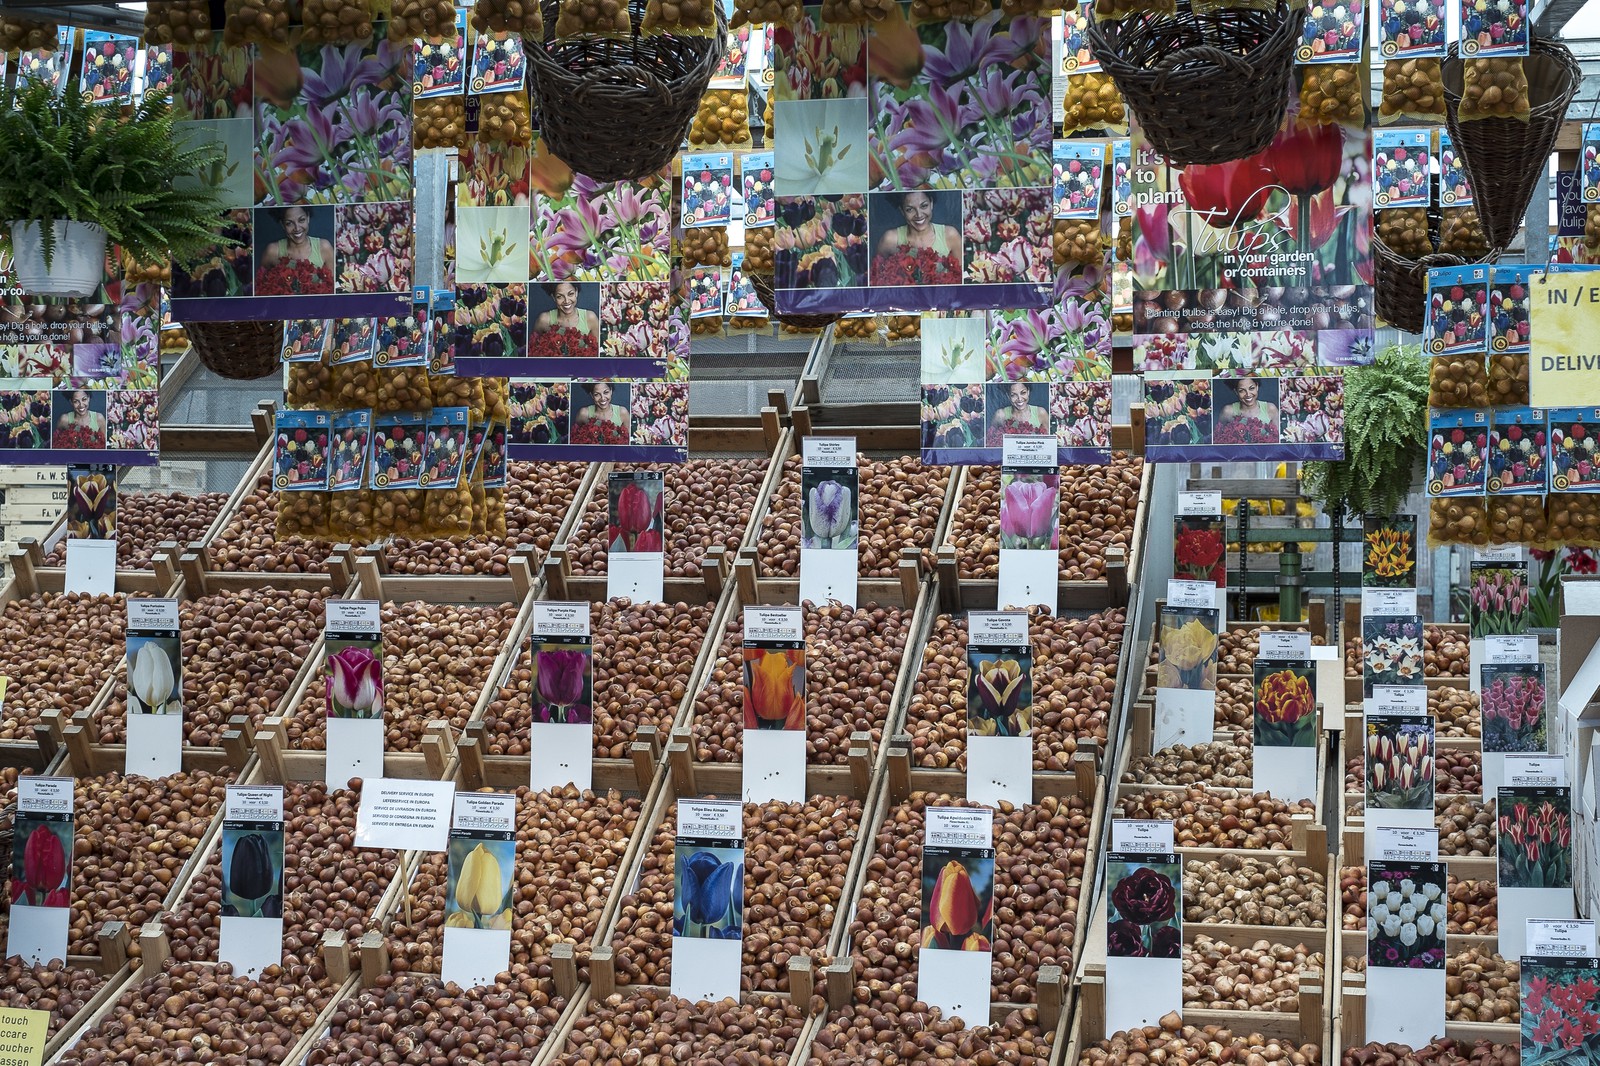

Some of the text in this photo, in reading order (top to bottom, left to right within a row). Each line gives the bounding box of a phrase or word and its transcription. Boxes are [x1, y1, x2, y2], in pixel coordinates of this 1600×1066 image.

[1136, 149, 1164, 165] It's
[1136, 169, 1156, 183] to
[1137, 188, 1184, 208] plant
[1168, 185, 1293, 270] Tulips
[1224, 250, 1315, 268] in your garden
[1224, 266, 1306, 278] or containers
[1548, 289, 1567, 304] IN
[1573, 286, 1583, 306] /
[1146, 309, 1180, 318] Planting
[1182, 308, 1206, 317] bulbs
[1208, 308, 1215, 316] is
[1217, 307, 1240, 318] easy!
[1242, 306, 1257, 316] Dig
[1266, 306, 1288, 315] hole,
[1290, 305, 1311, 316] drop
[1311, 306, 1331, 315] your
[1333, 304, 1360, 314] bulbs,
[11, 322, 24, 331] Dig
[31, 322, 49, 330] hole,
[50, 321, 68, 331] drop
[68, 322, 85, 330] your
[86, 321, 109, 330] bulbs,
[1191, 321, 1215, 329] close
[1216, 319, 1231, 328] the
[1232, 319, 1251, 328] hole
[1289, 318, 1314, 327] done!
[49, 472, 58, 480] W.
[1, 1015, 29, 1026] touch
